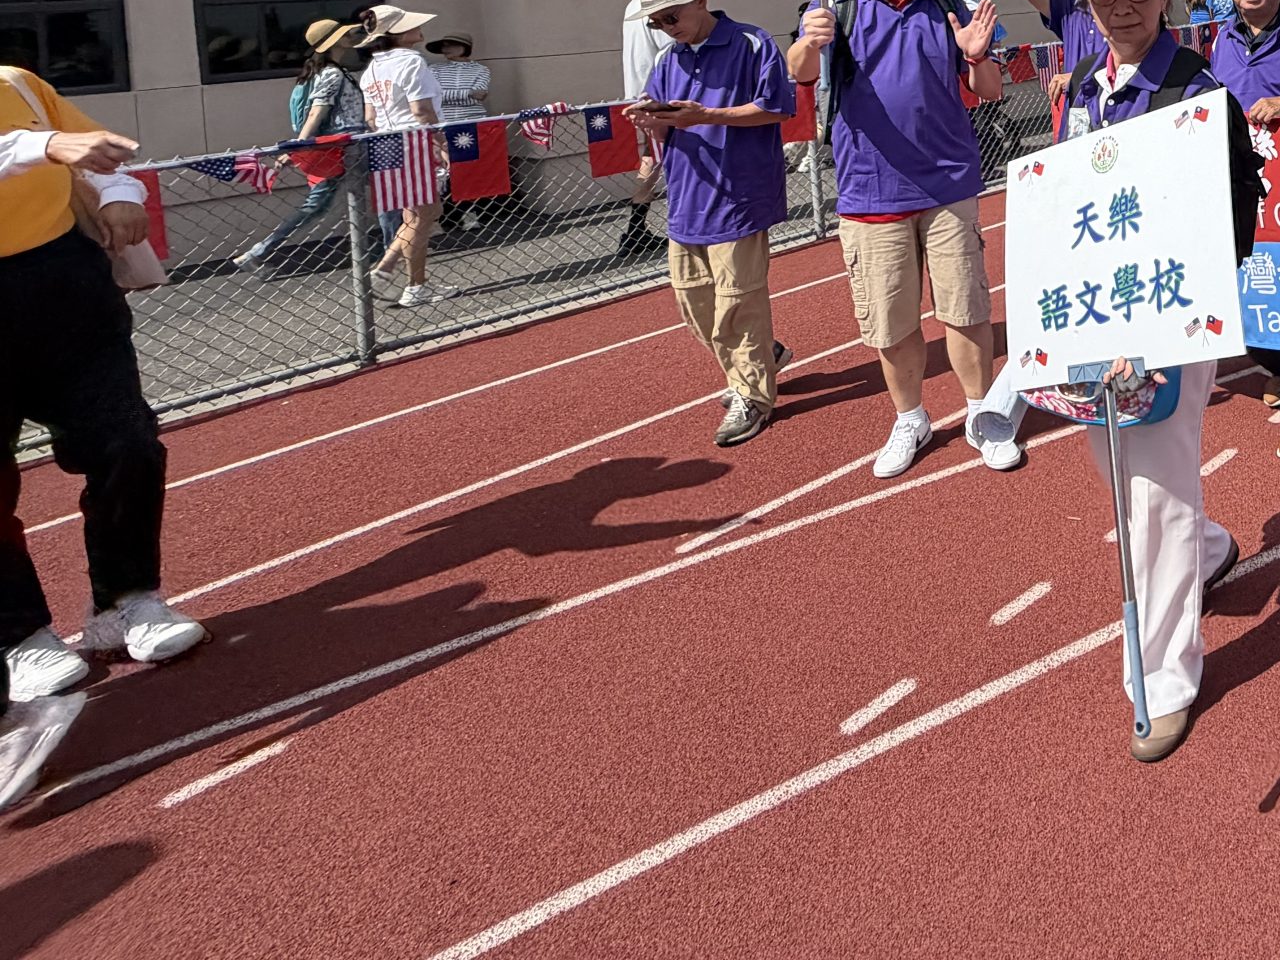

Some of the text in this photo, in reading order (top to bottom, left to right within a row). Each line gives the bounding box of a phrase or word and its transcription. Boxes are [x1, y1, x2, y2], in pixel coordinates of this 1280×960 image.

[1071, 185, 1143, 249] 天樂
[1037, 257, 1194, 332] 語文學校
